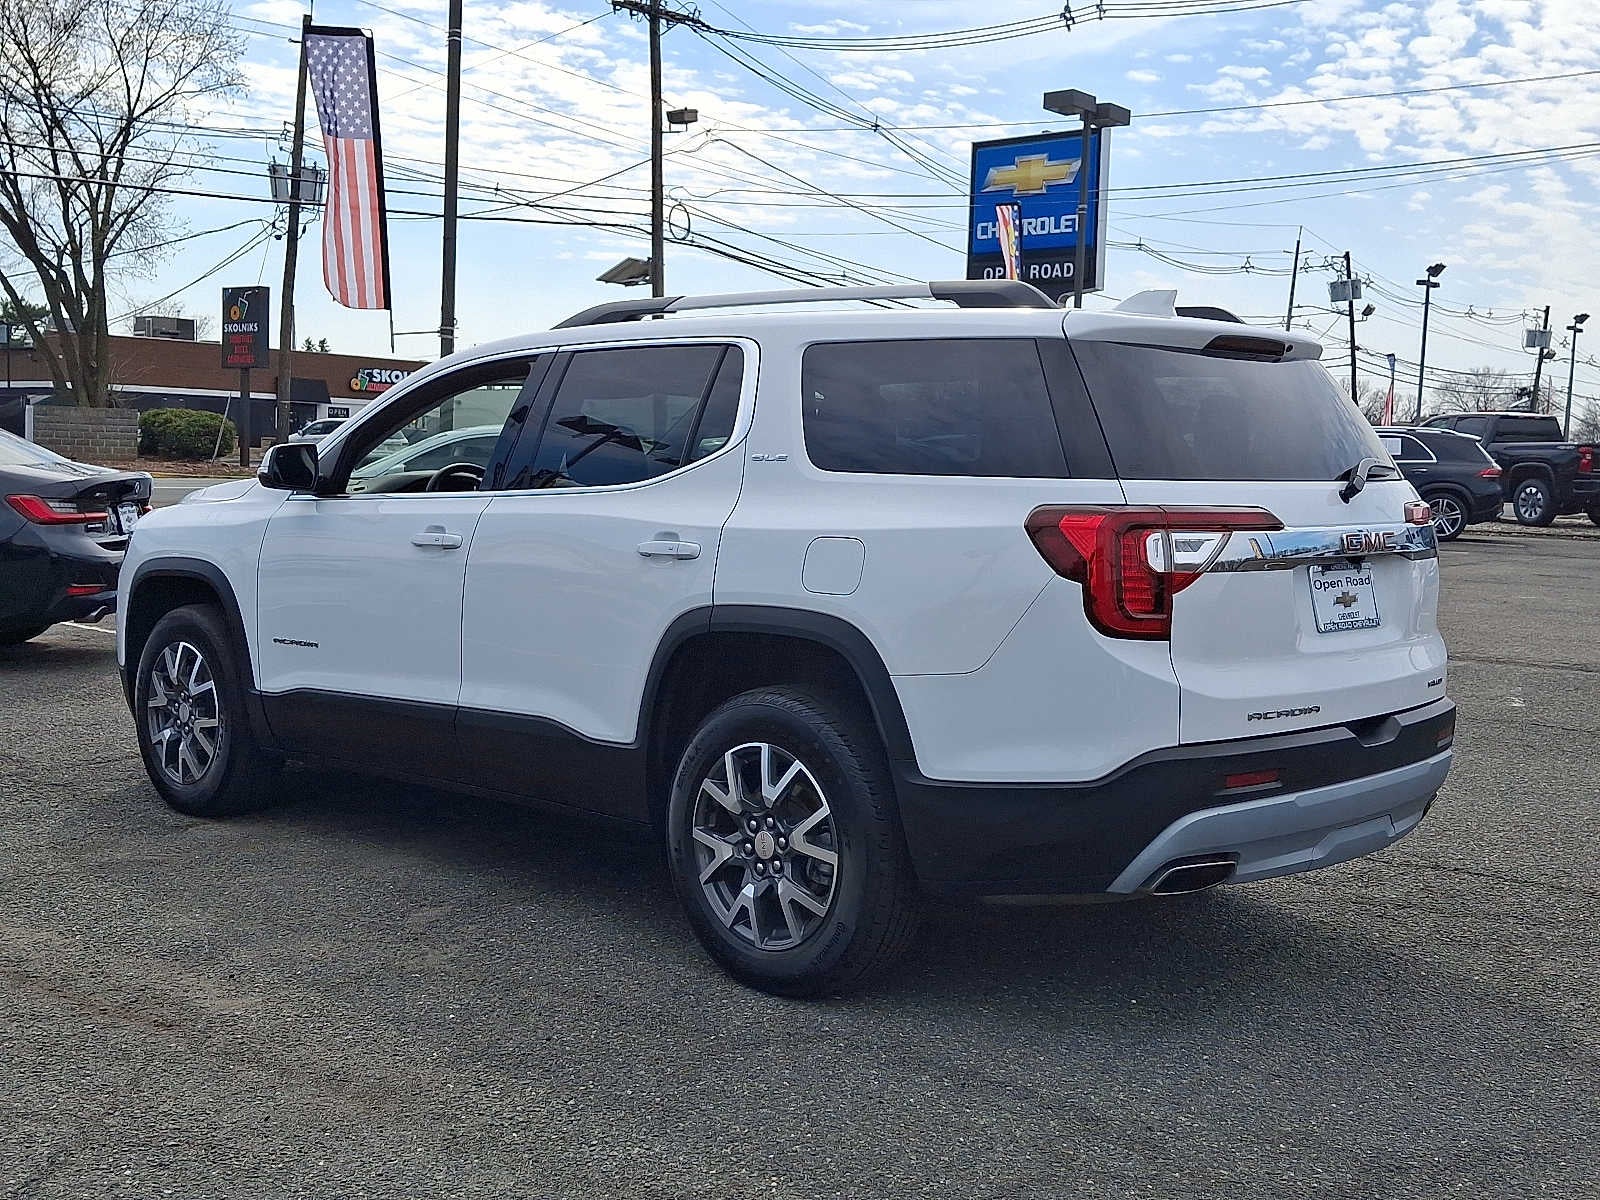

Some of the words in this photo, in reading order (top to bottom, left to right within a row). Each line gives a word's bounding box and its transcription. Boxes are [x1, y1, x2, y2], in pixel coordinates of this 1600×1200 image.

[976, 214, 1079, 240] CHROLET
[1029, 262, 1074, 279] ROAD
[223, 322, 259, 333] SKOLNIKS
[1344, 531, 1397, 553] GMC
[1313, 578, 1343, 592] Open
[1345, 574, 1371, 587] Road
[1247, 705, 1321, 721] ACADIA
